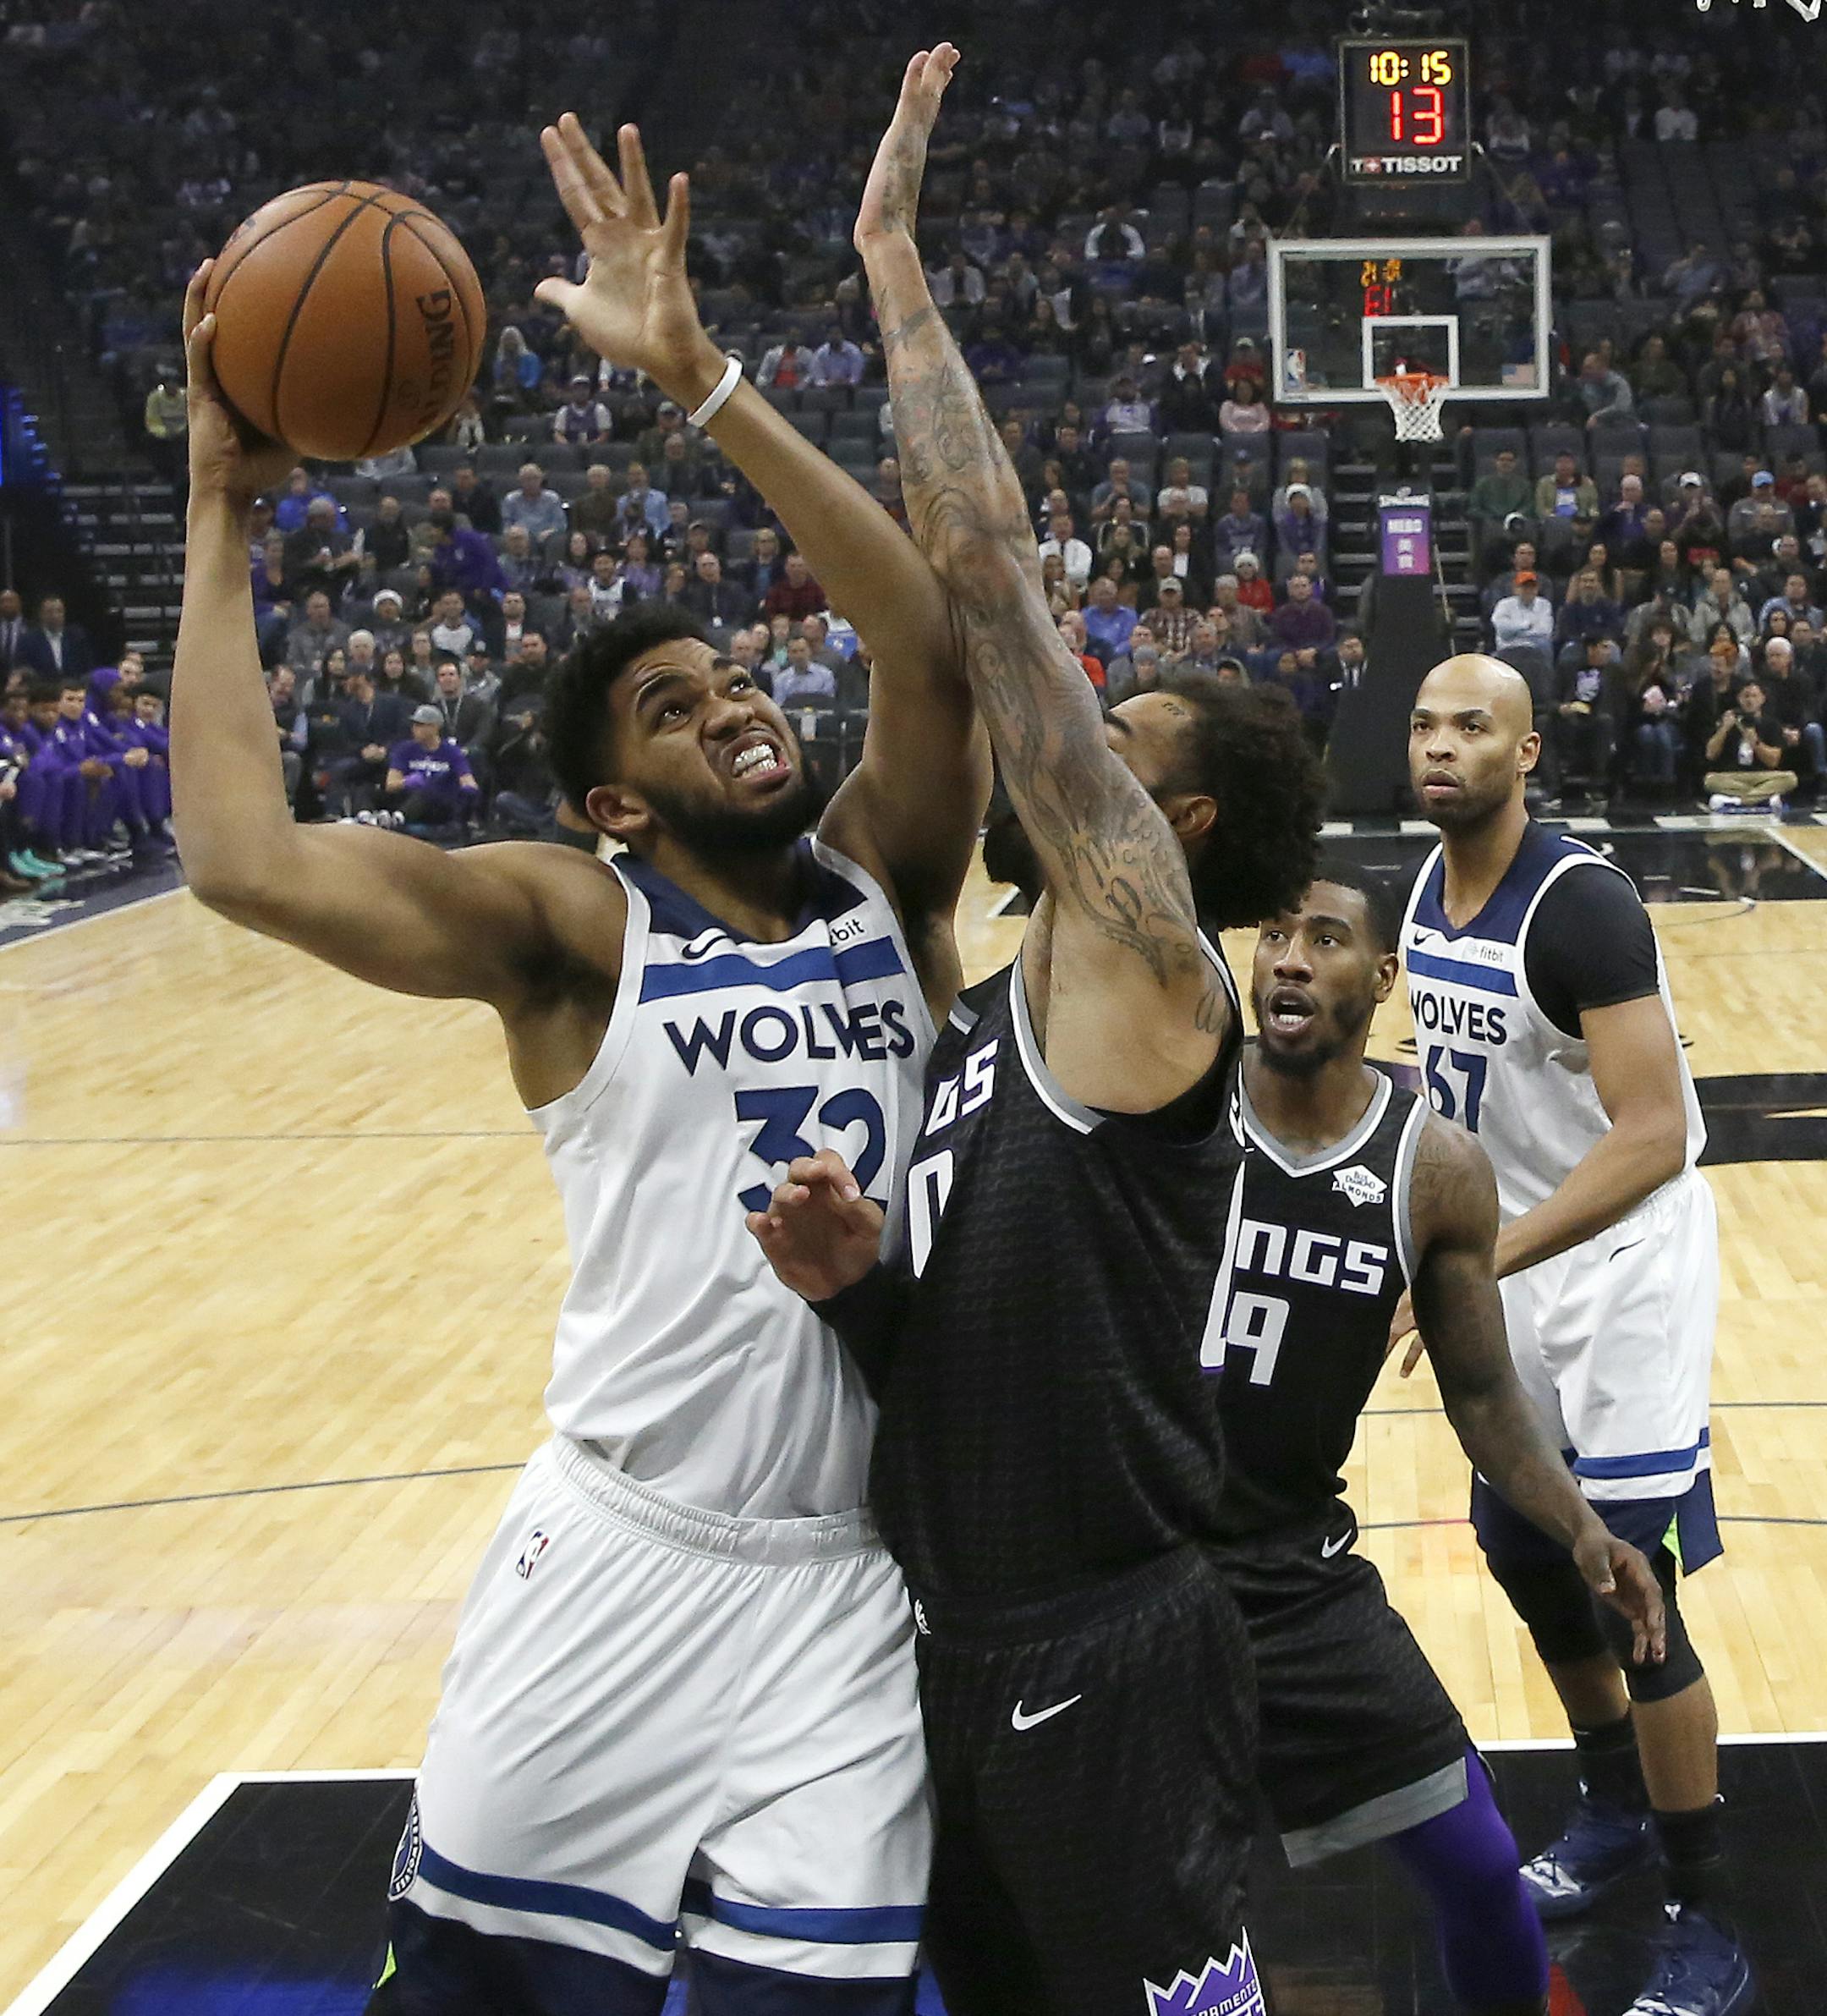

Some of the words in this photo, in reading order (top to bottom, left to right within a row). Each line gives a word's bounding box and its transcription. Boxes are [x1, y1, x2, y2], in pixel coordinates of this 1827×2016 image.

[1369, 51, 1452, 85] 10:15
[1391, 87, 1444, 145] 13
[1381, 156, 1462, 173] TISSOT
[1479, 945, 1503, 963] fitbit
[662, 999, 915, 1078] WOLVES
[1425, 1044, 1487, 1134] 67
[733, 1085, 889, 1214] 32
[1335, 1181, 1381, 1202] ALMONDS
[1234, 1217, 1389, 1296] NGS
